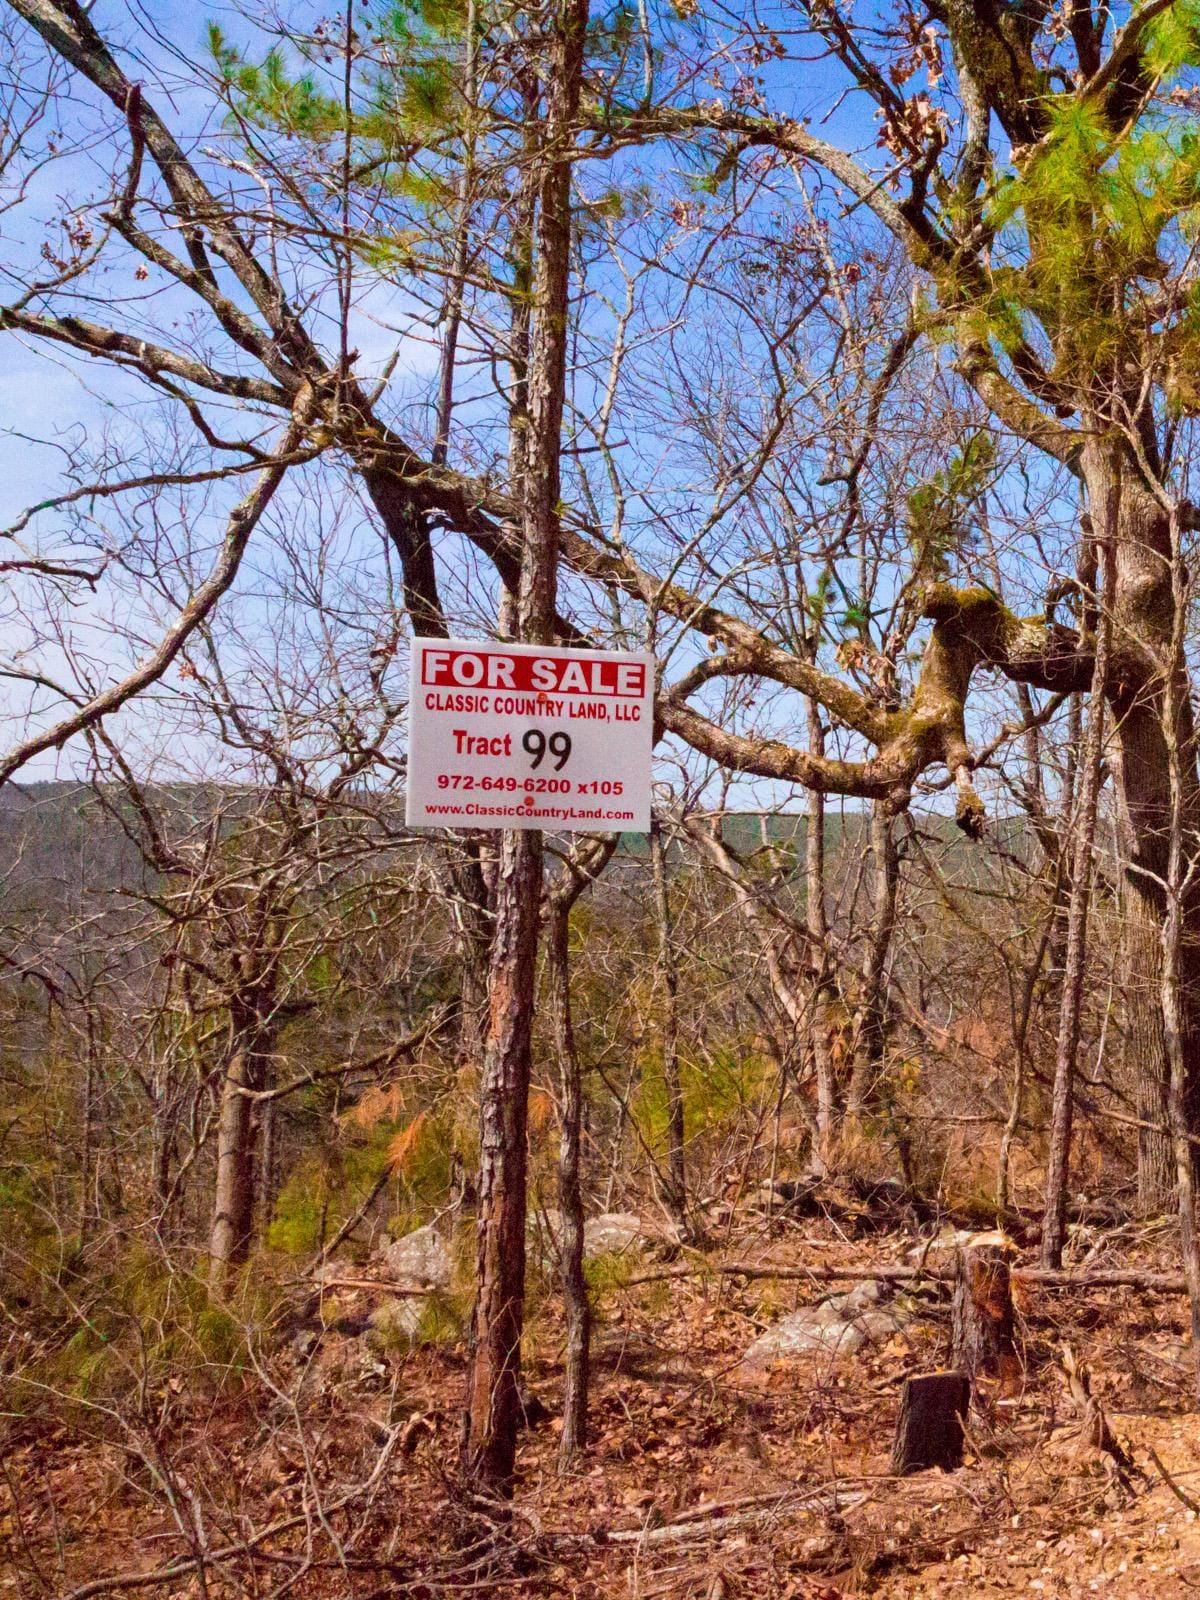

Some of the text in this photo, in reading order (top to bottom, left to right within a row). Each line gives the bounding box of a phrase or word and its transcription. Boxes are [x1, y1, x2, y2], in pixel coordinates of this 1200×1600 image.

[425, 651, 642, 696] FOR SALE
[425, 693, 641, 723] CLASSIC COUNTRY LAND, LLC
[453, 729, 572, 772] Tract 99
[437, 774, 623, 795] 972-649-6200 x105
[425, 803, 634, 820] www.ClassicCountryLand.com
